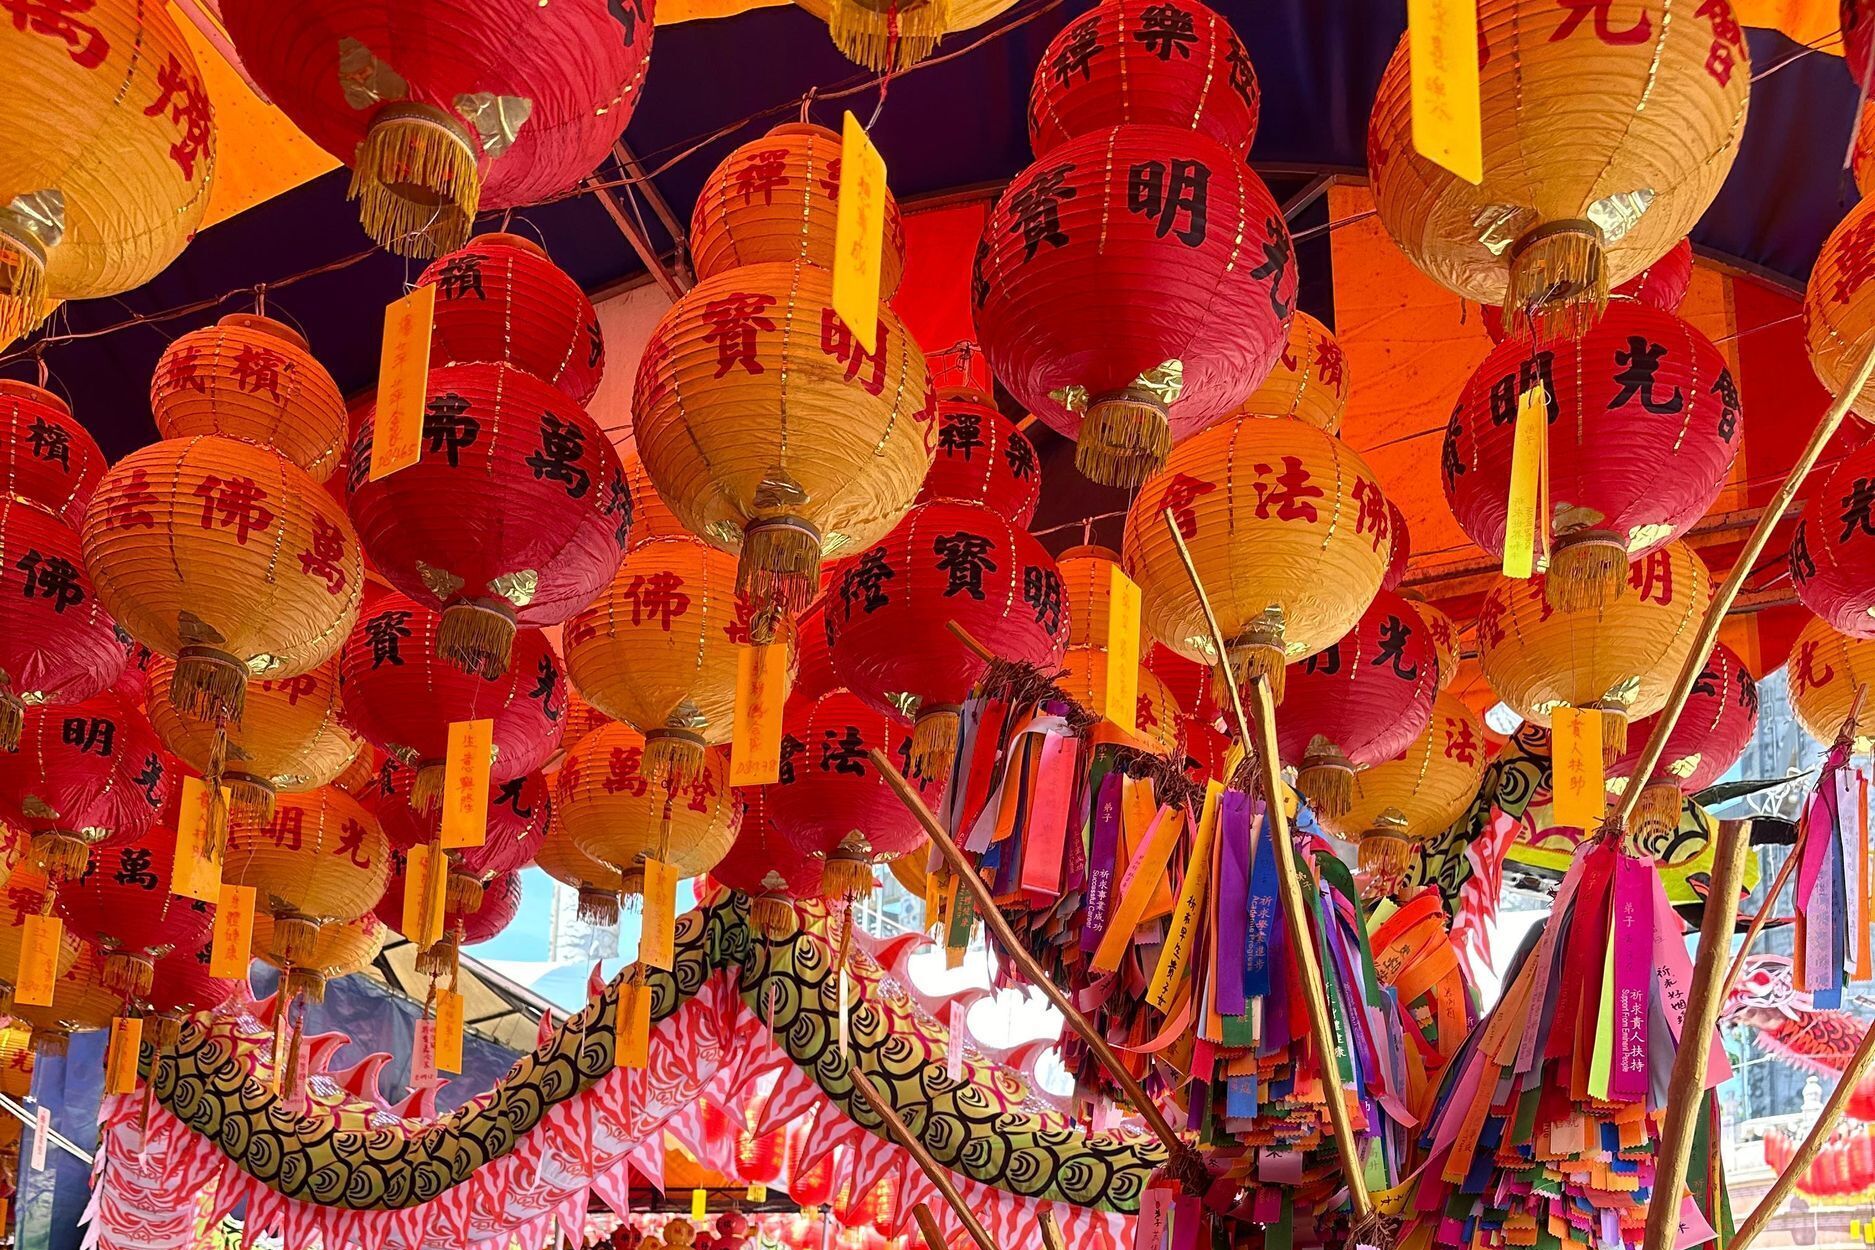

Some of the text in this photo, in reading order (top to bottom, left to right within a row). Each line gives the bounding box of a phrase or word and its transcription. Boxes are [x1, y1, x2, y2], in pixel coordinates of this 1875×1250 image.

[1127, 157, 1212, 248] 明
[1606, 334, 1684, 416] 光
[192, 472, 277, 546] 佛
[1252, 455, 1325, 524] 法
[1629, 988, 1645, 1073] 祈求貴人扶持
